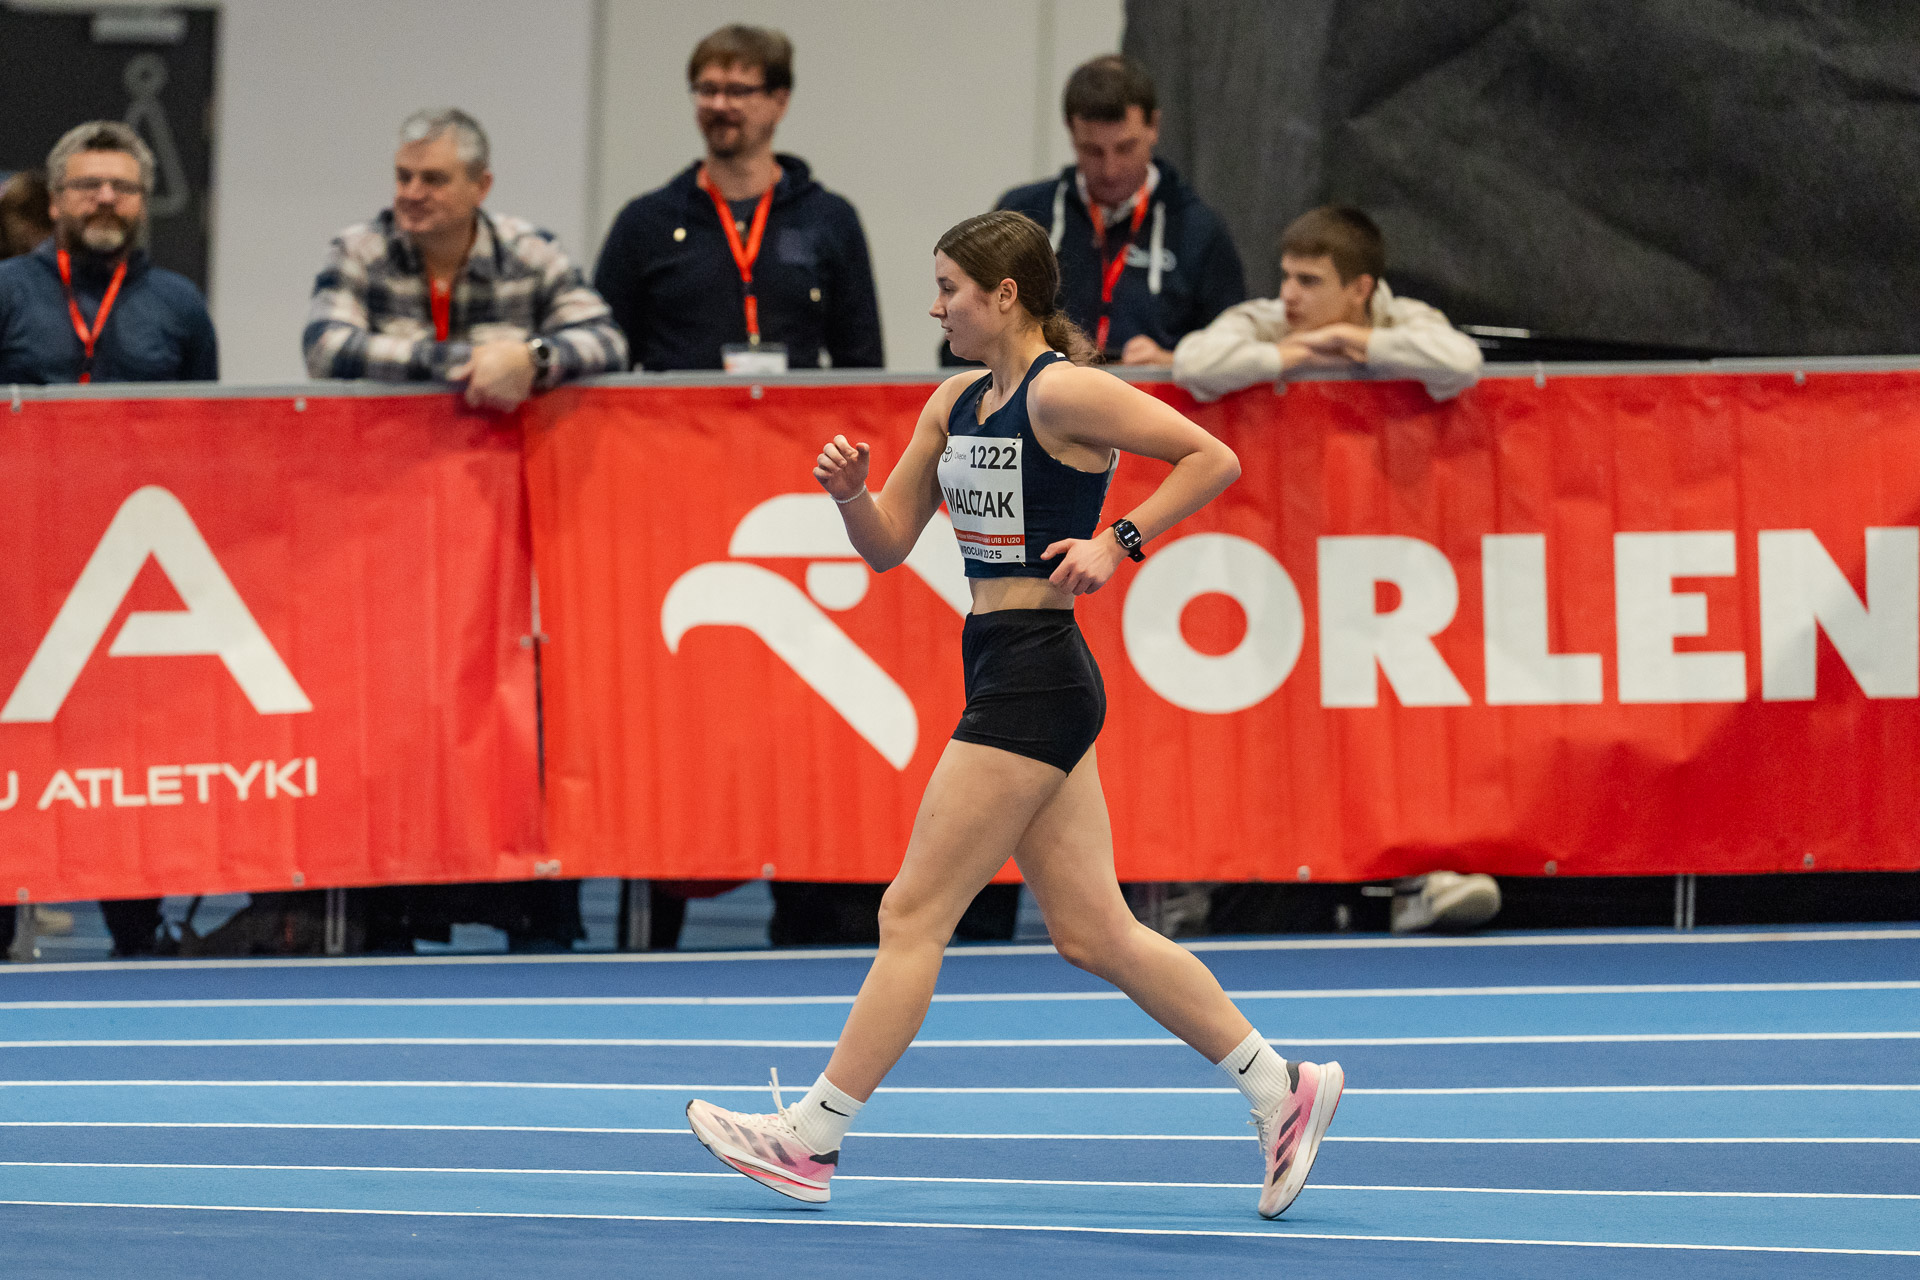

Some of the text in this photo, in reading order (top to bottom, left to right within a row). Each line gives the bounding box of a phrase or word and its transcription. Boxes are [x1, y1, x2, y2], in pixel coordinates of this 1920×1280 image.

[970, 445, 1017, 470] 1222
[943, 487, 1015, 518] WALCZAK
[1121, 526, 1920, 715] ORLEN
[37, 756, 319, 811] ATLETYKI
